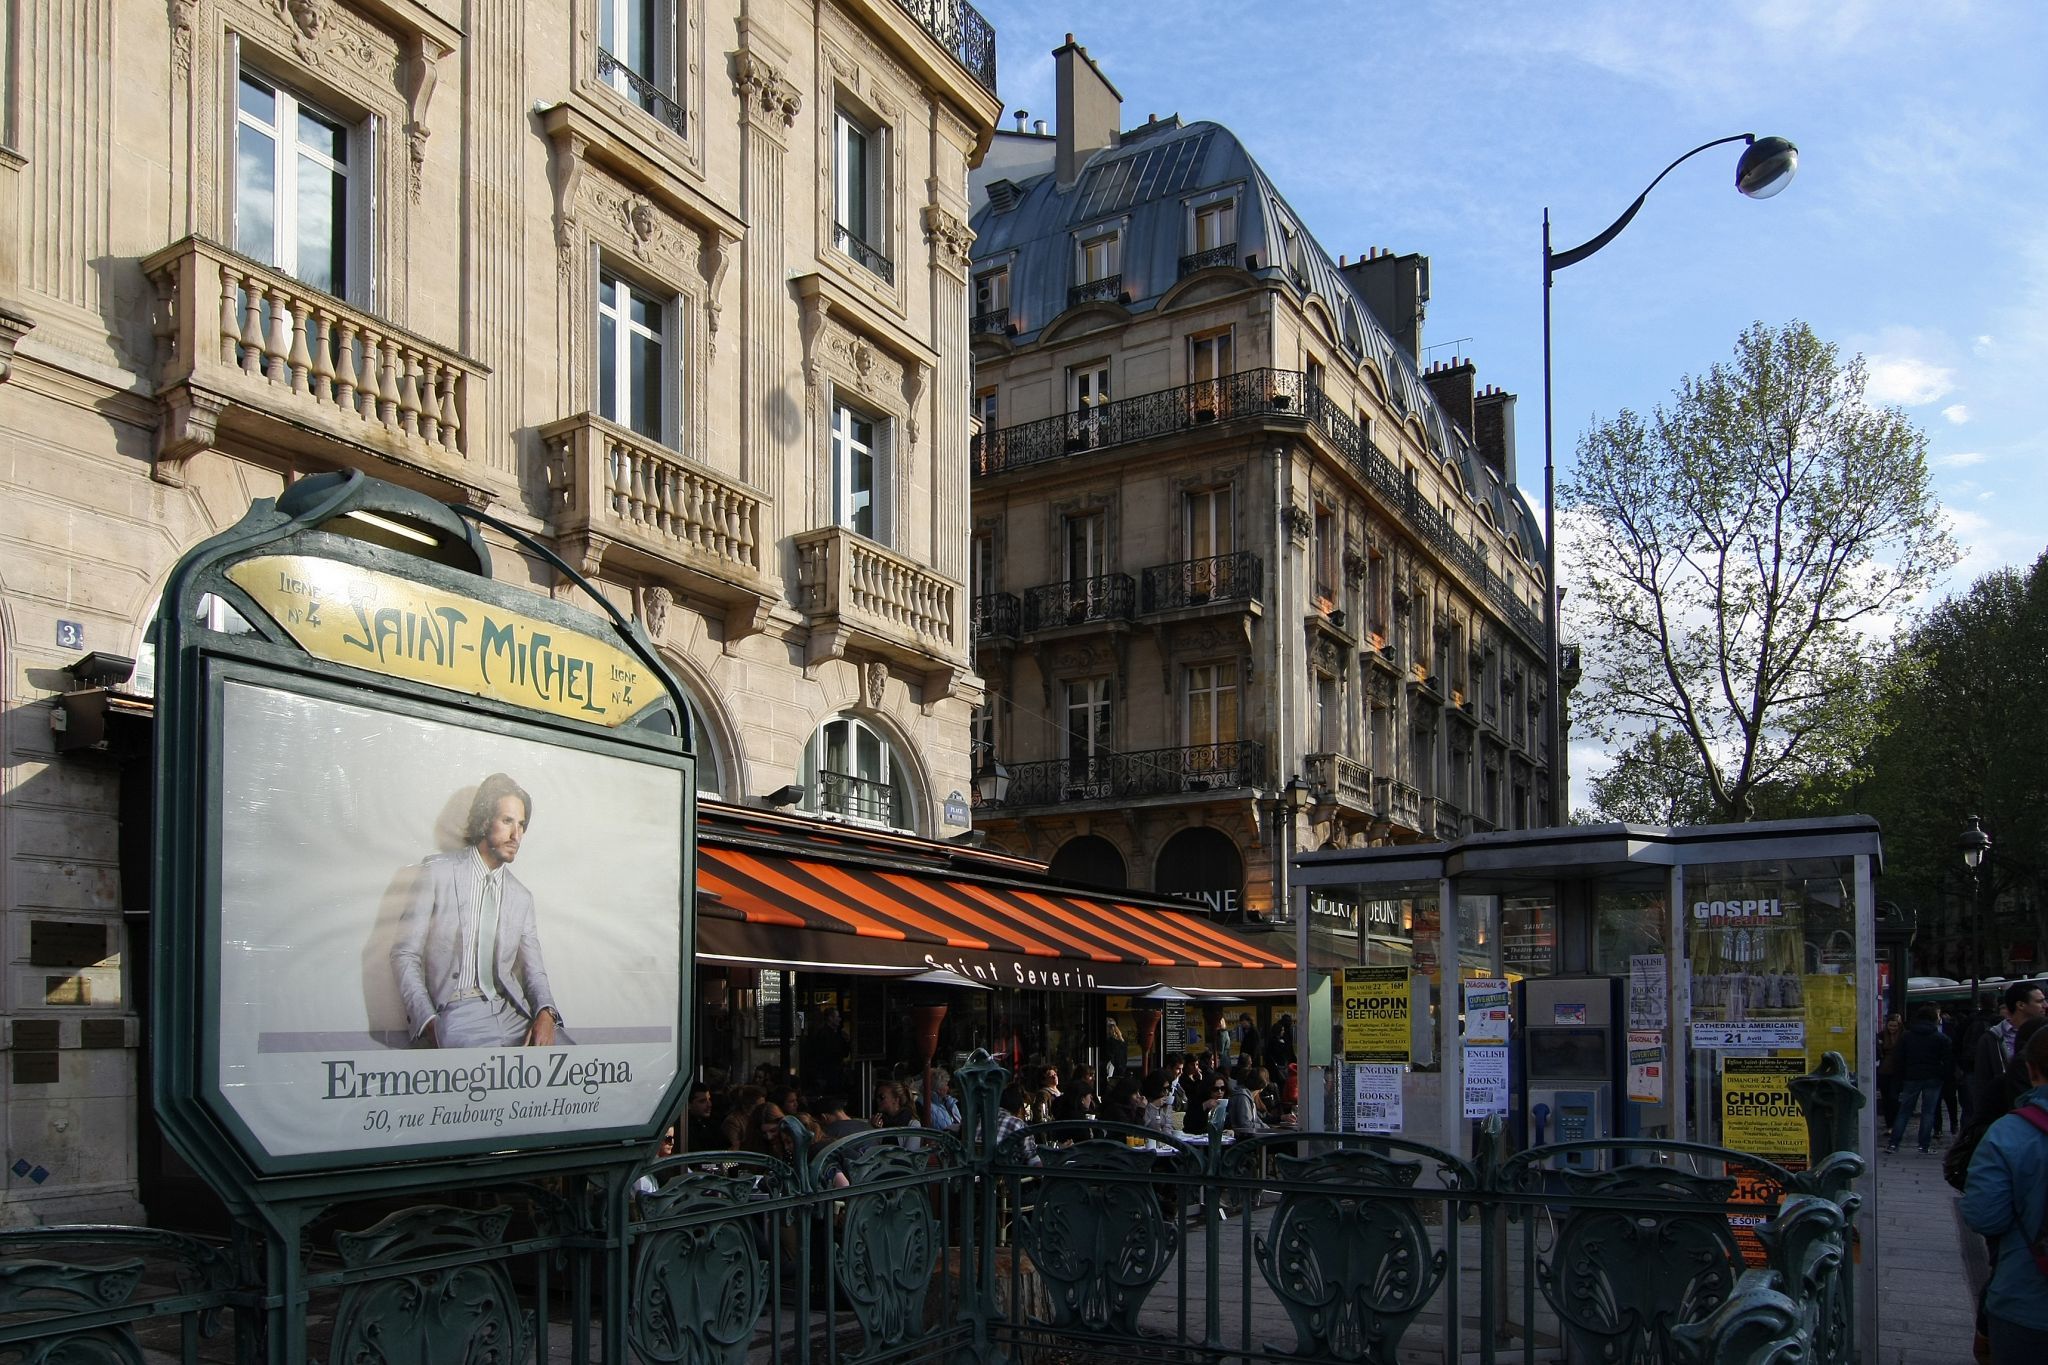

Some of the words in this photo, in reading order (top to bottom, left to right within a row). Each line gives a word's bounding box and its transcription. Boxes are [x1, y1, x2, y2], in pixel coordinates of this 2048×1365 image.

[278, 572, 321, 599] LIGNE
[306, 601, 321, 628] 4
[64, 625, 76, 645] 3
[610, 664, 637, 685] LIGNE
[623, 686, 632, 707] 4
[1693, 899, 1782, 919] GOSPEL
[1633, 958, 1662, 967] ENGLISH
[924, 954, 999, 981] Saint
[1013, 962, 1095, 988] Severin
[1345, 997, 1407, 1010] CHOPIN
[1346, 1009, 1407, 1020] BEETHOVEN
[1725, 1033, 1742, 1044] 21
[1467, 1050, 1505, 1058] ENGLISH
[1360, 1066, 1398, 1074] ENGLISH
[320, 1055, 542, 1102] Ermenegildo
[545, 1052, 633, 1093] Zegna
[1467, 1077, 1500, 1085] BOOKS!
[1760, 1076, 1772, 1084] 22
[1360, 1092, 1393, 1100] BOOKS!
[362, 1109, 393, 1133] 50,
[398, 1112, 425, 1128] rue
[429, 1103, 505, 1127] Faubourg
[508, 1097, 601, 1120] Saint-Honoré
[1727, 1105, 1805, 1117] BEETHOVEN
